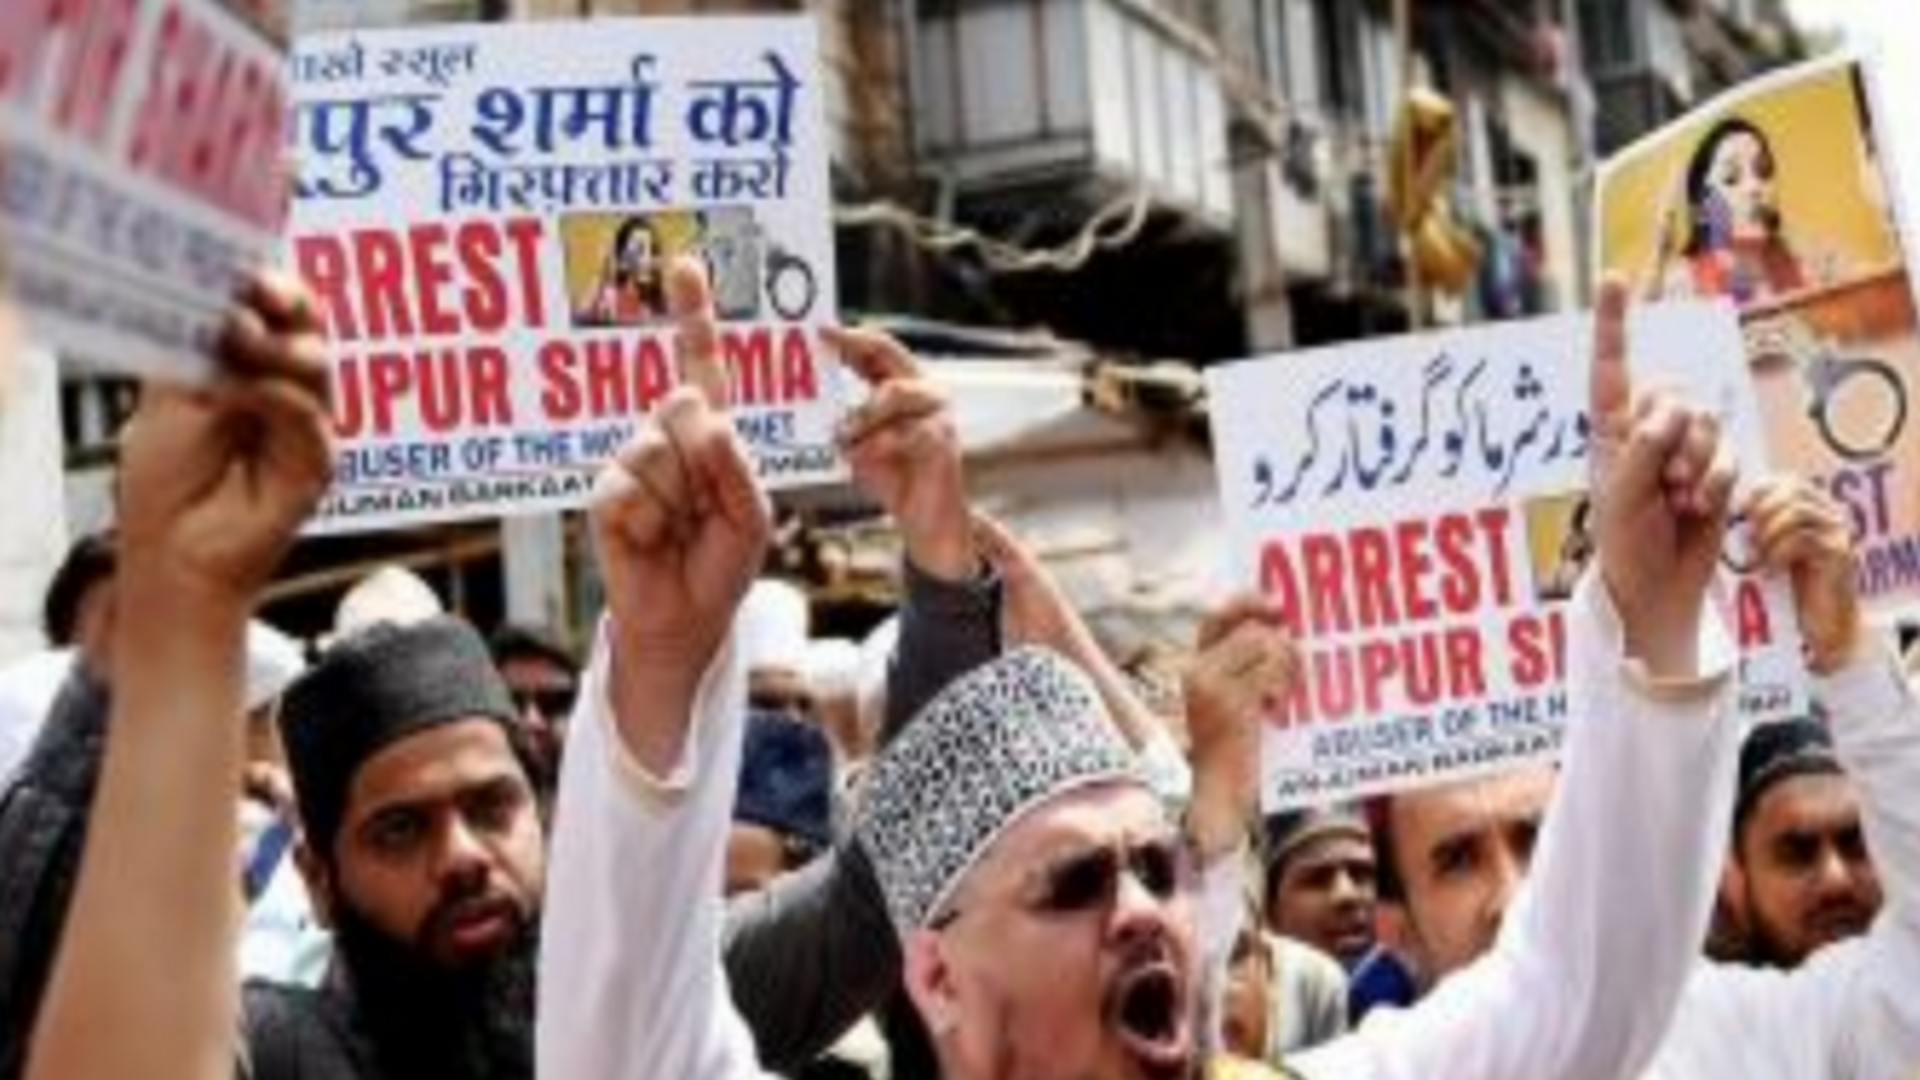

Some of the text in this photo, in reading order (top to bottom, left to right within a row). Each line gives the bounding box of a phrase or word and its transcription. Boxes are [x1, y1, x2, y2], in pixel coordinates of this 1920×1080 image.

[471, 54, 661, 155] शर्मा
[687, 50, 802, 148] को
[691, 144, 789, 200] करो
[293, 217, 545, 342] RREST
[332, 327, 819, 439] UPUR SHAMA
[340, 441, 450, 484] BUSER
[460, 435, 504, 471] OF
[1258, 506, 1513, 640] ARREST
